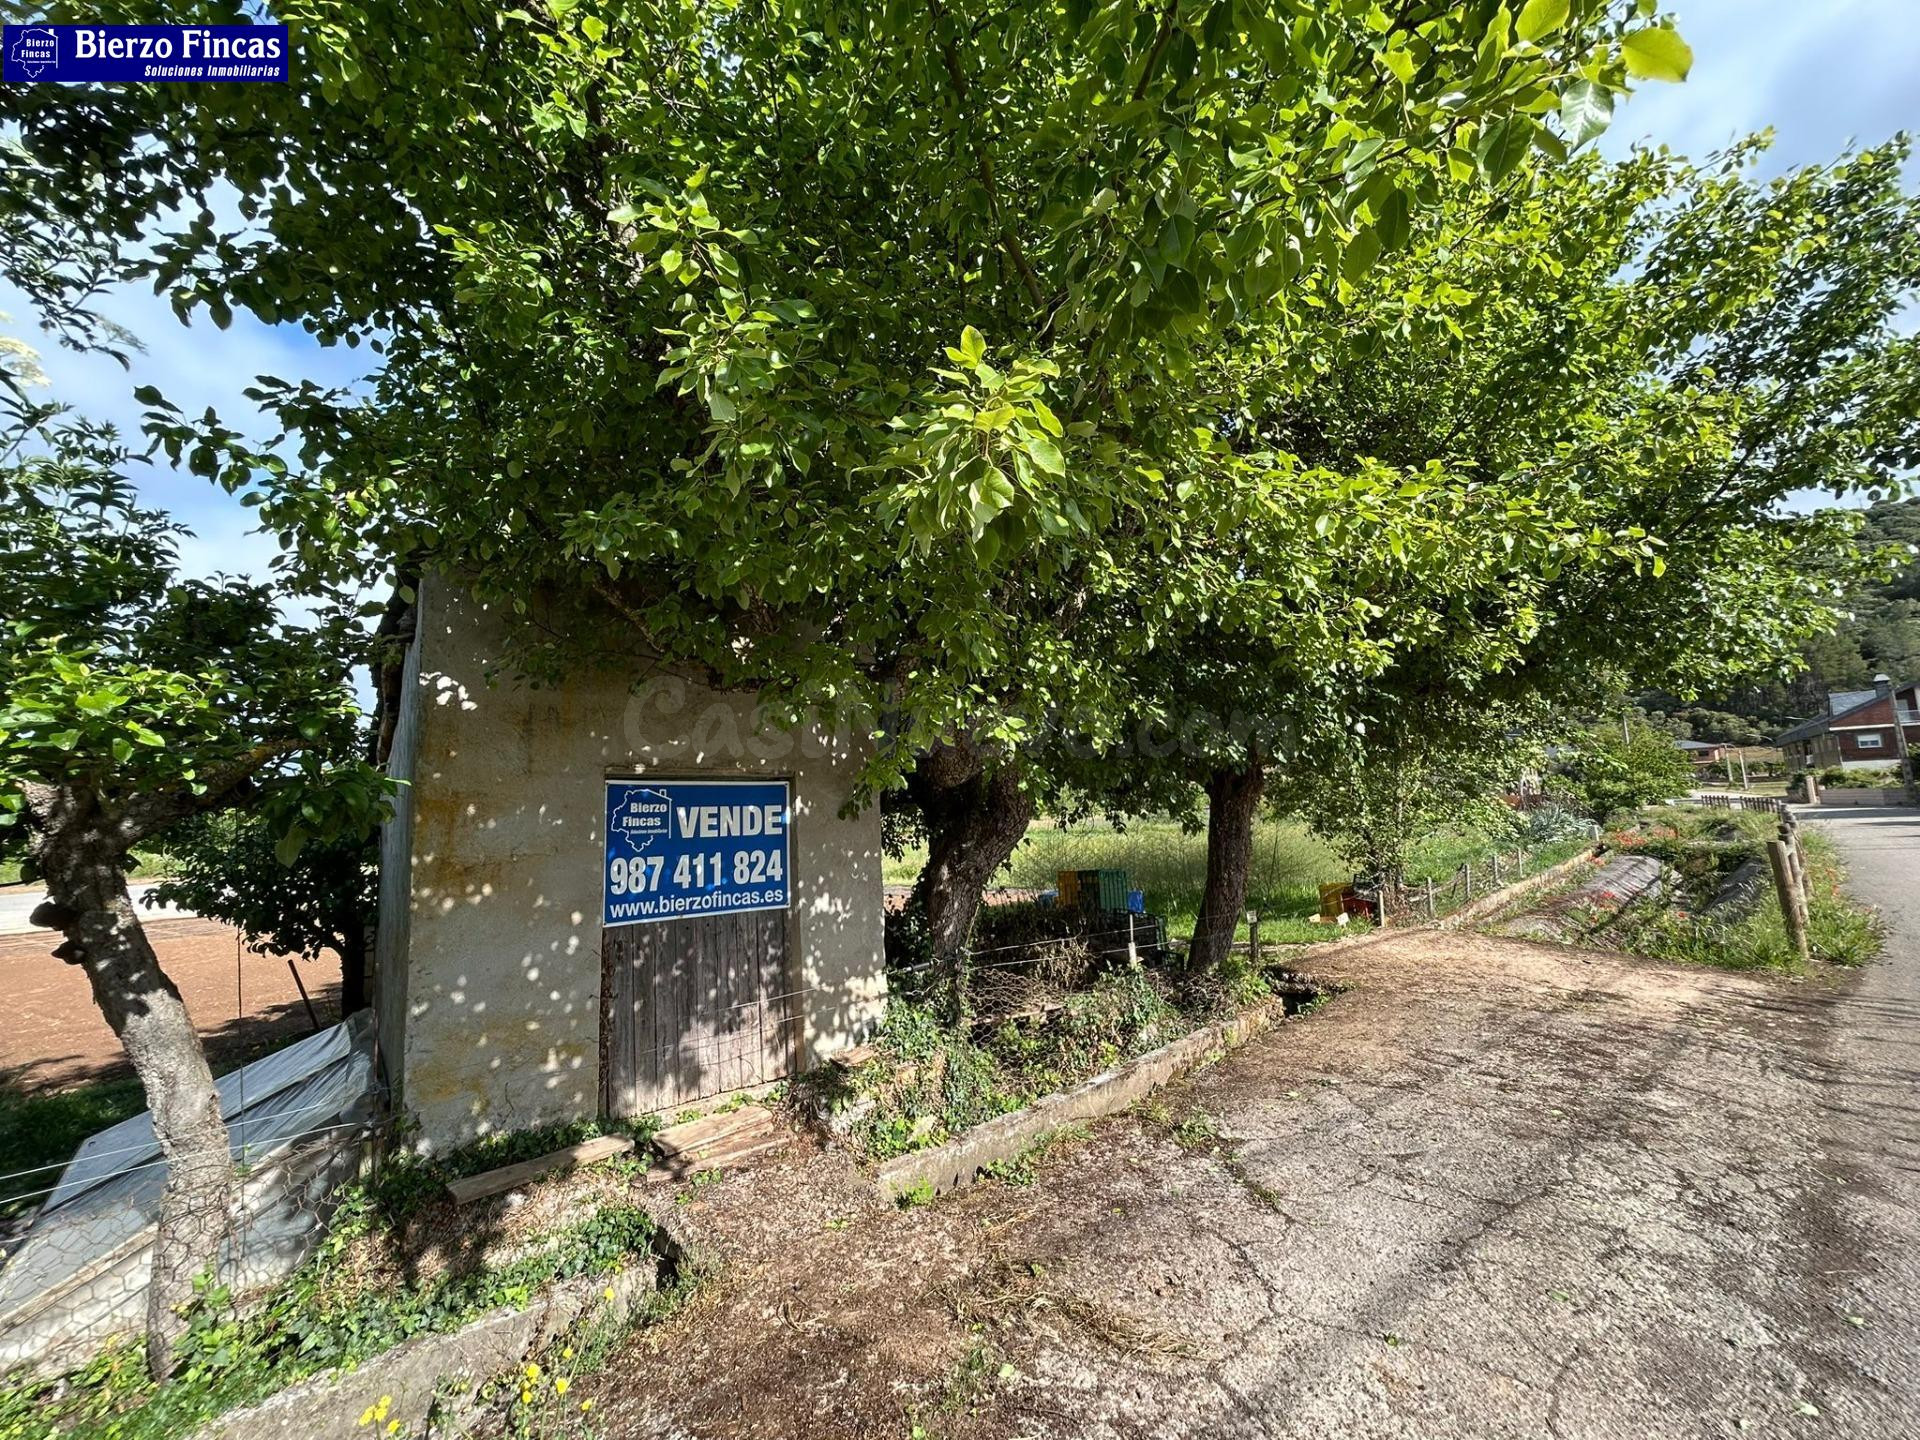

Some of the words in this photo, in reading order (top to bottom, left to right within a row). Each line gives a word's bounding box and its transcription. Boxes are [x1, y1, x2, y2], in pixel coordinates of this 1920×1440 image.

[622, 816, 662, 827] Fincas
[630, 802, 668, 813] Bierzo
[676, 805, 783, 839] VENDE
[610, 856, 665, 895] 987
[673, 852, 722, 889] 411
[733, 849, 783, 885] 824
[610, 889, 784, 918] www.bierzofincas.es
